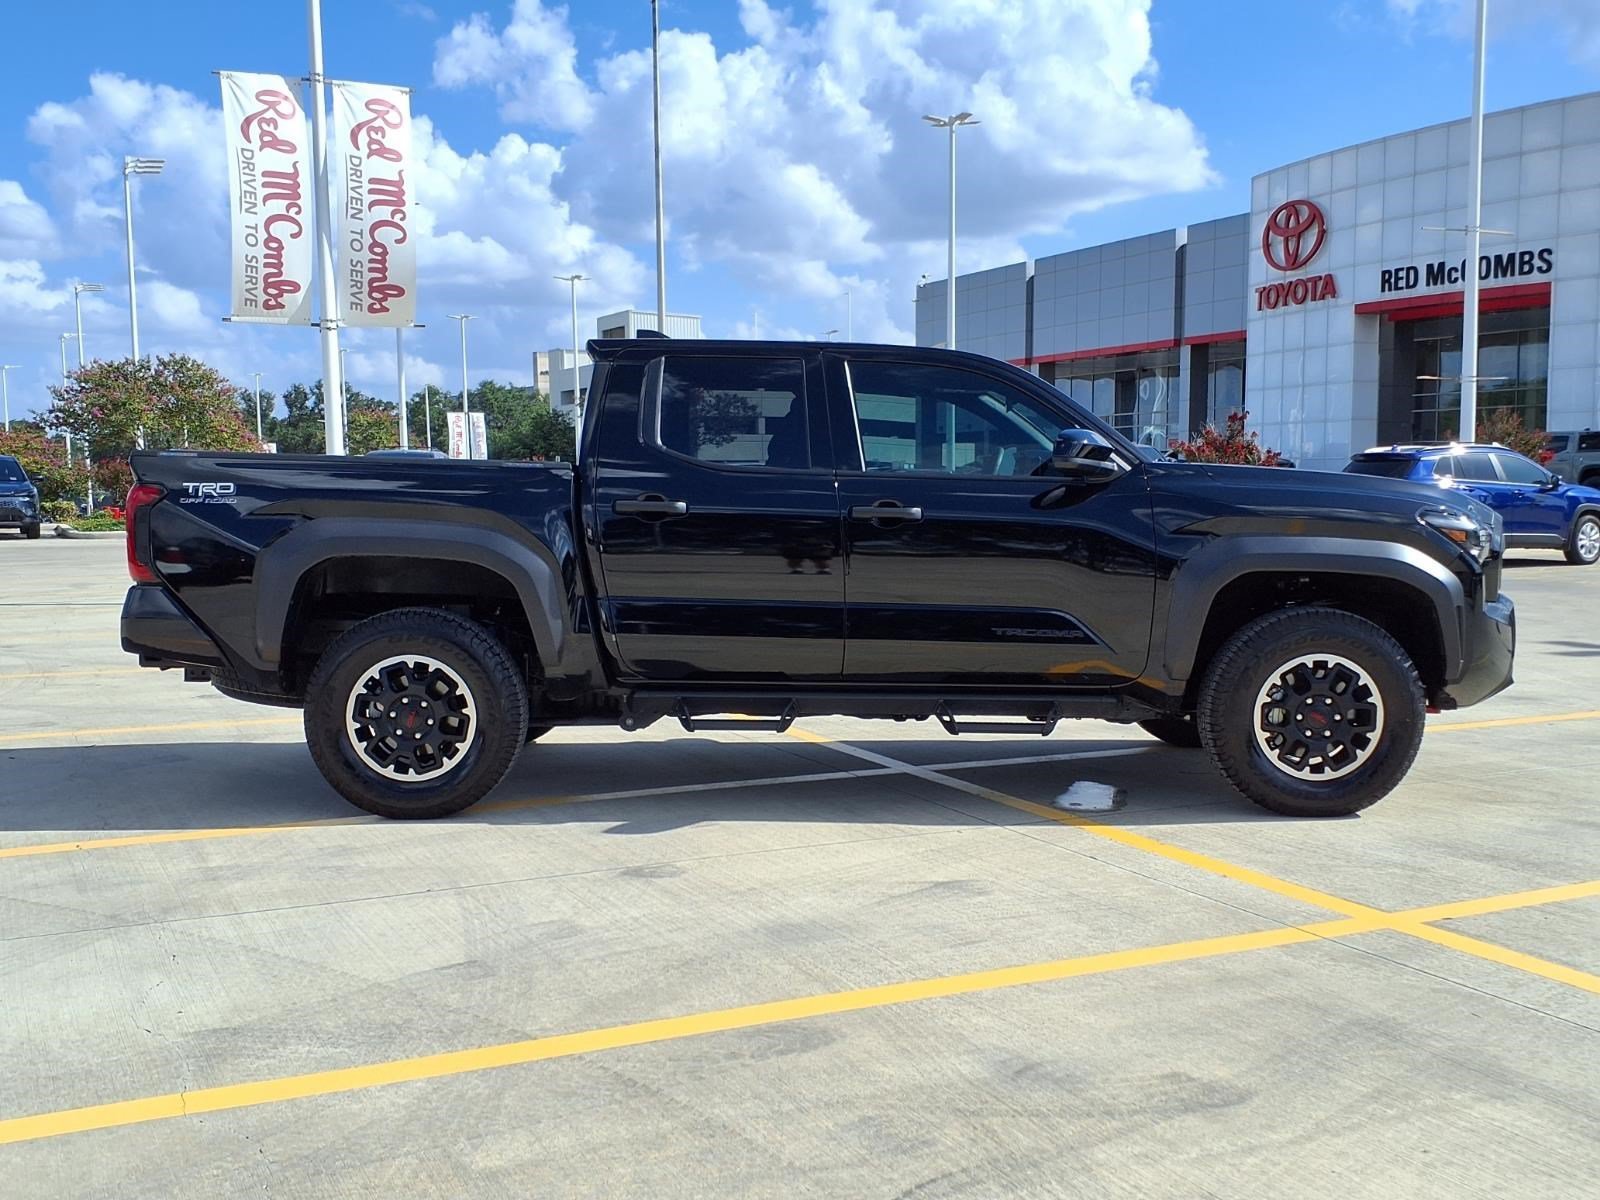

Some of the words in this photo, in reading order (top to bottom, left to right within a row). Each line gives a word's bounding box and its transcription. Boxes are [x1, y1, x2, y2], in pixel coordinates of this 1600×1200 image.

[240, 89, 298, 155] Red
[350, 97, 403, 163] Red
[240, 147, 259, 216] DRIVEN
[349, 154, 364, 221] DRIVEN
[244, 223, 259, 248] TO
[261, 160, 303, 311] McCombs
[350, 228, 364, 253] TO
[367, 169, 408, 315] McCombs
[244, 254, 259, 309] SERVE
[350, 259, 364, 312] SERVE
[1255, 273, 1337, 311] TOYOTA
[1381, 265, 1419, 293] RED
[182, 482, 236, 497] TRD
[991, 627, 1085, 638] TACOMA
